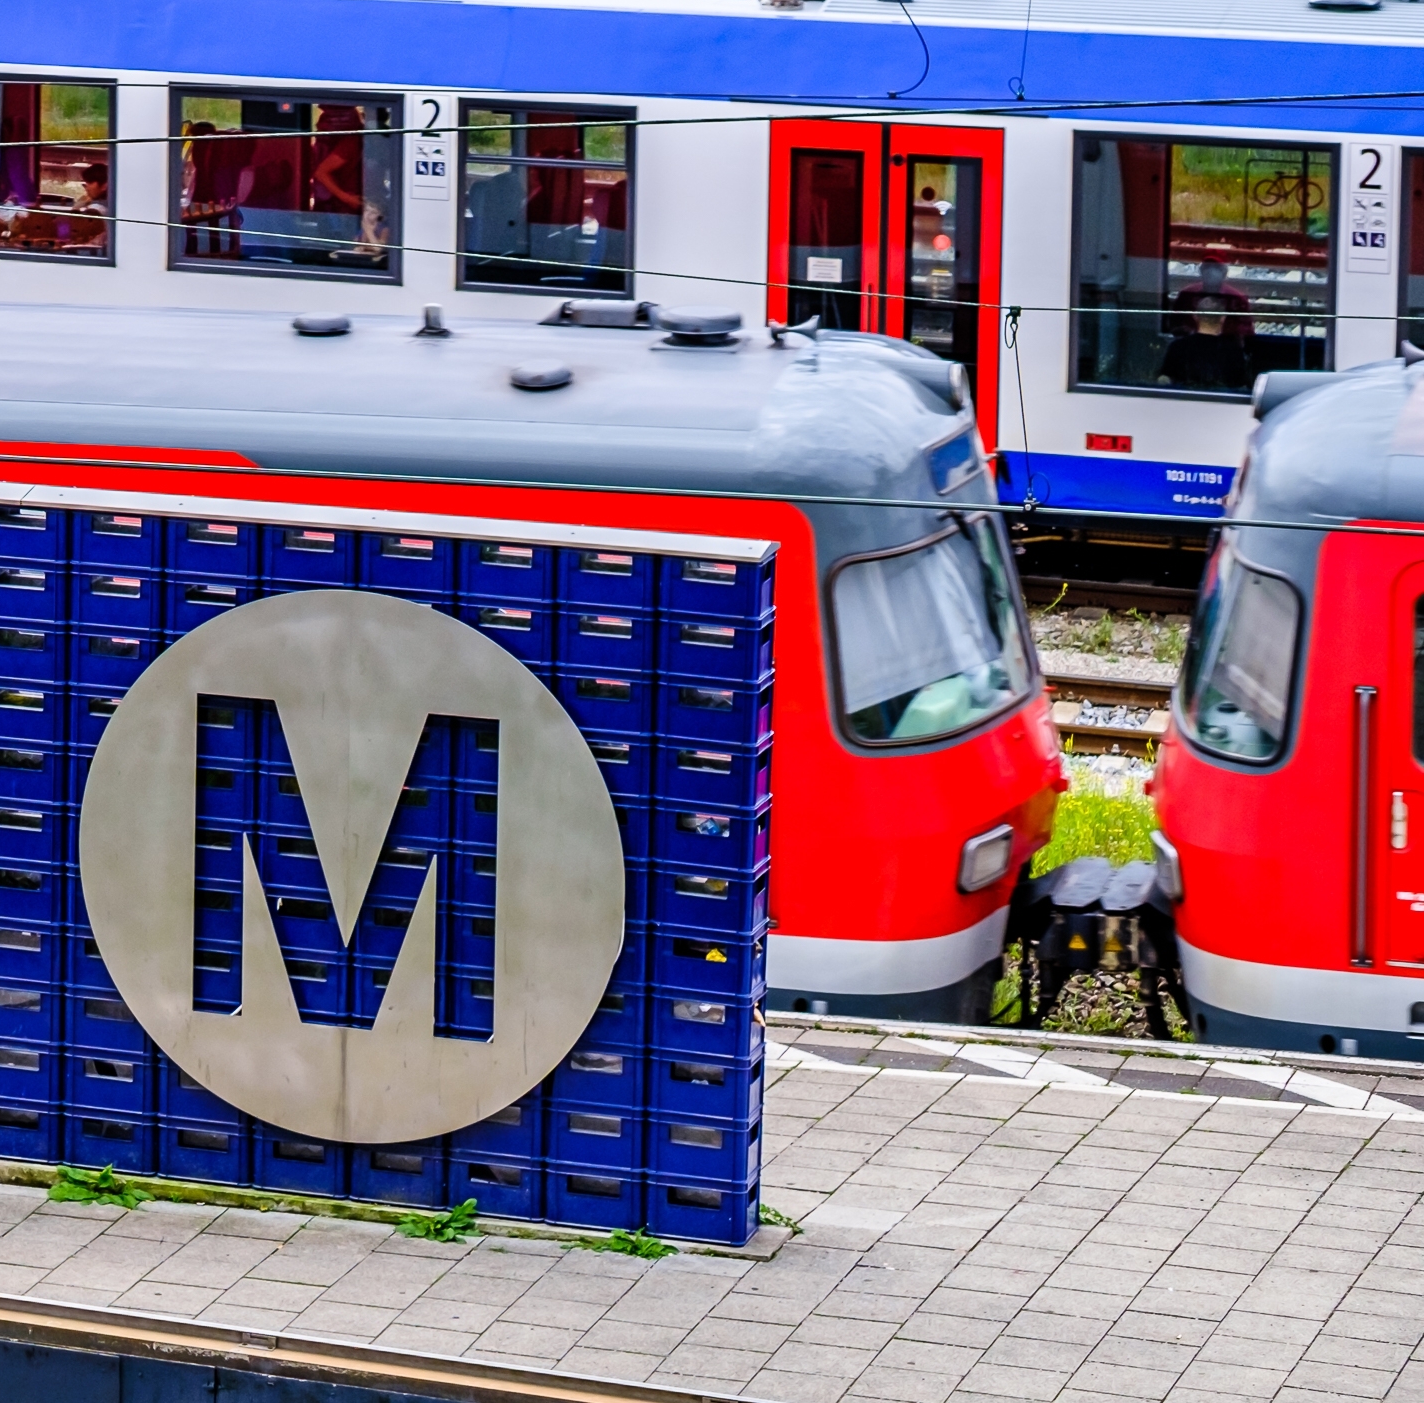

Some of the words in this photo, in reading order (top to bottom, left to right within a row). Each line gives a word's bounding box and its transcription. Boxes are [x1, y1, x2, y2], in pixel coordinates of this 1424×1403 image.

[420, 99, 441, 137] 2
[1359, 148, 1382, 189] 2
[192, 692, 501, 1043] M
